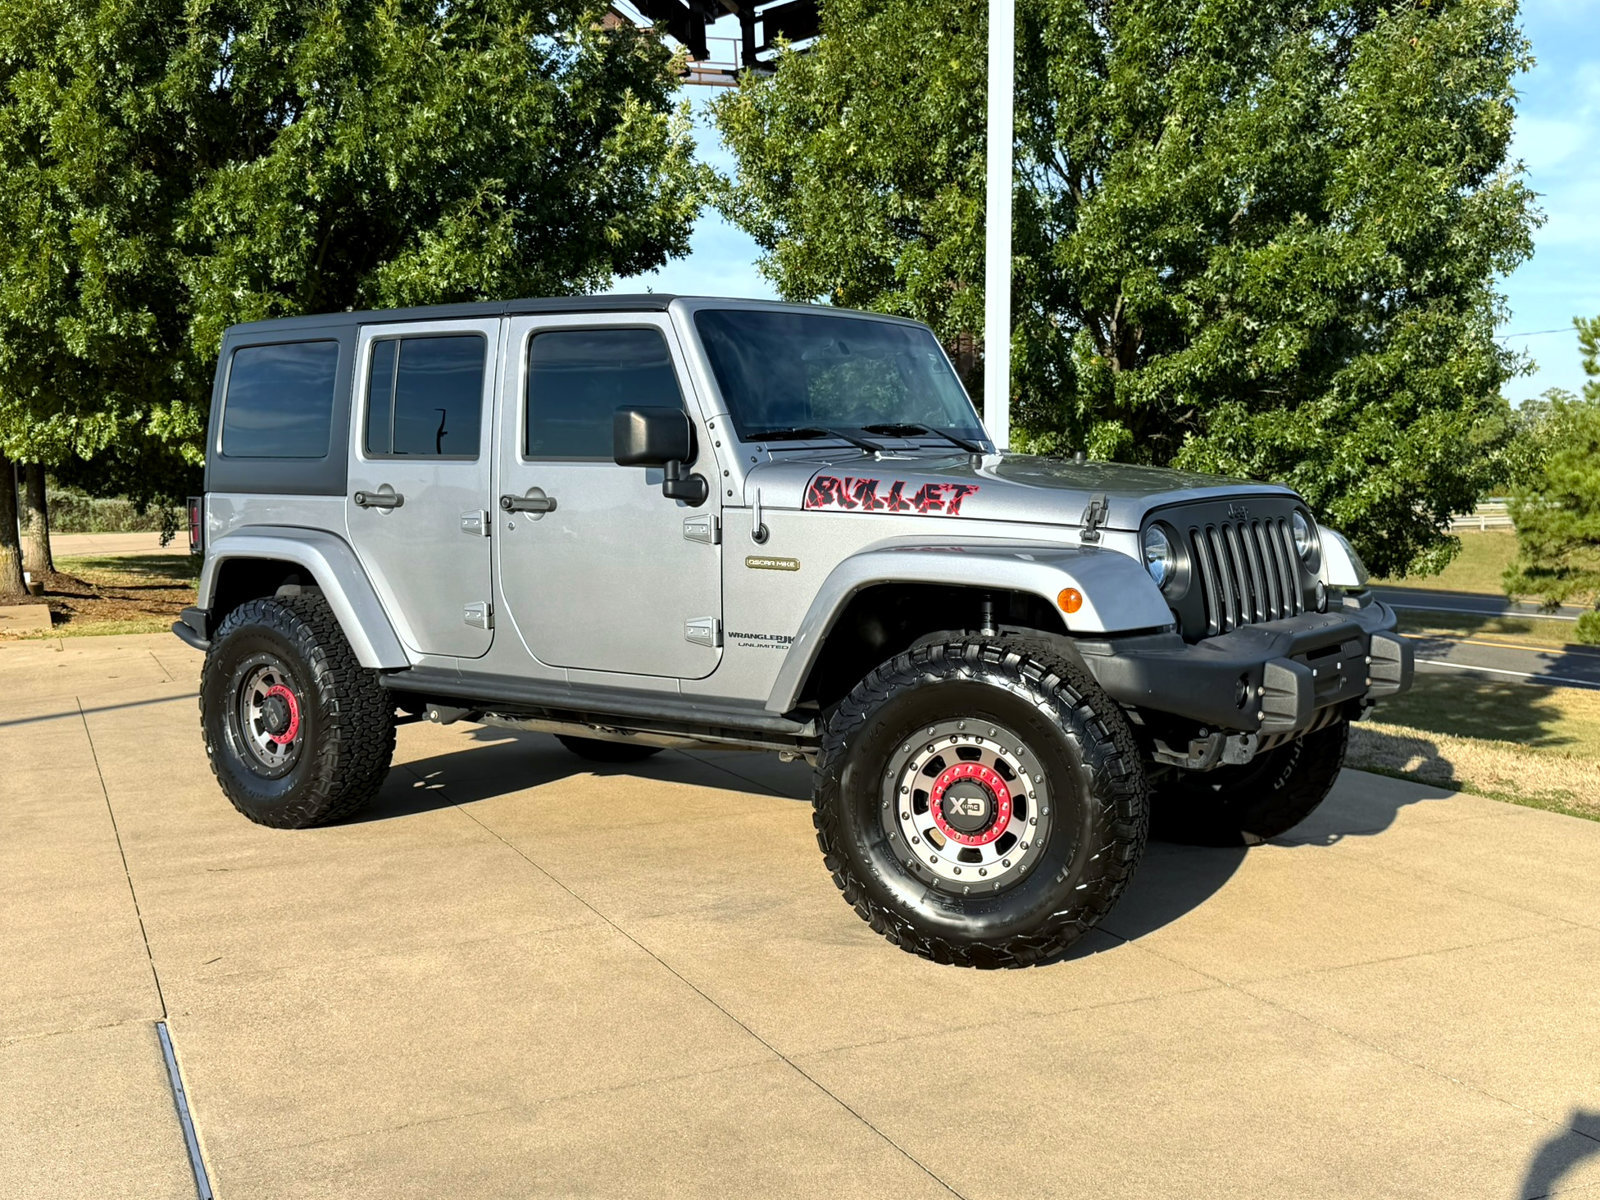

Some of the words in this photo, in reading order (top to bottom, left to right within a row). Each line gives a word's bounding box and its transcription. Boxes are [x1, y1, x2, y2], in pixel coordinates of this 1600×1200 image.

[806, 475, 980, 516] BULLET
[738, 642, 789, 650] UNLIMITED
[949, 796, 985, 817] XD
